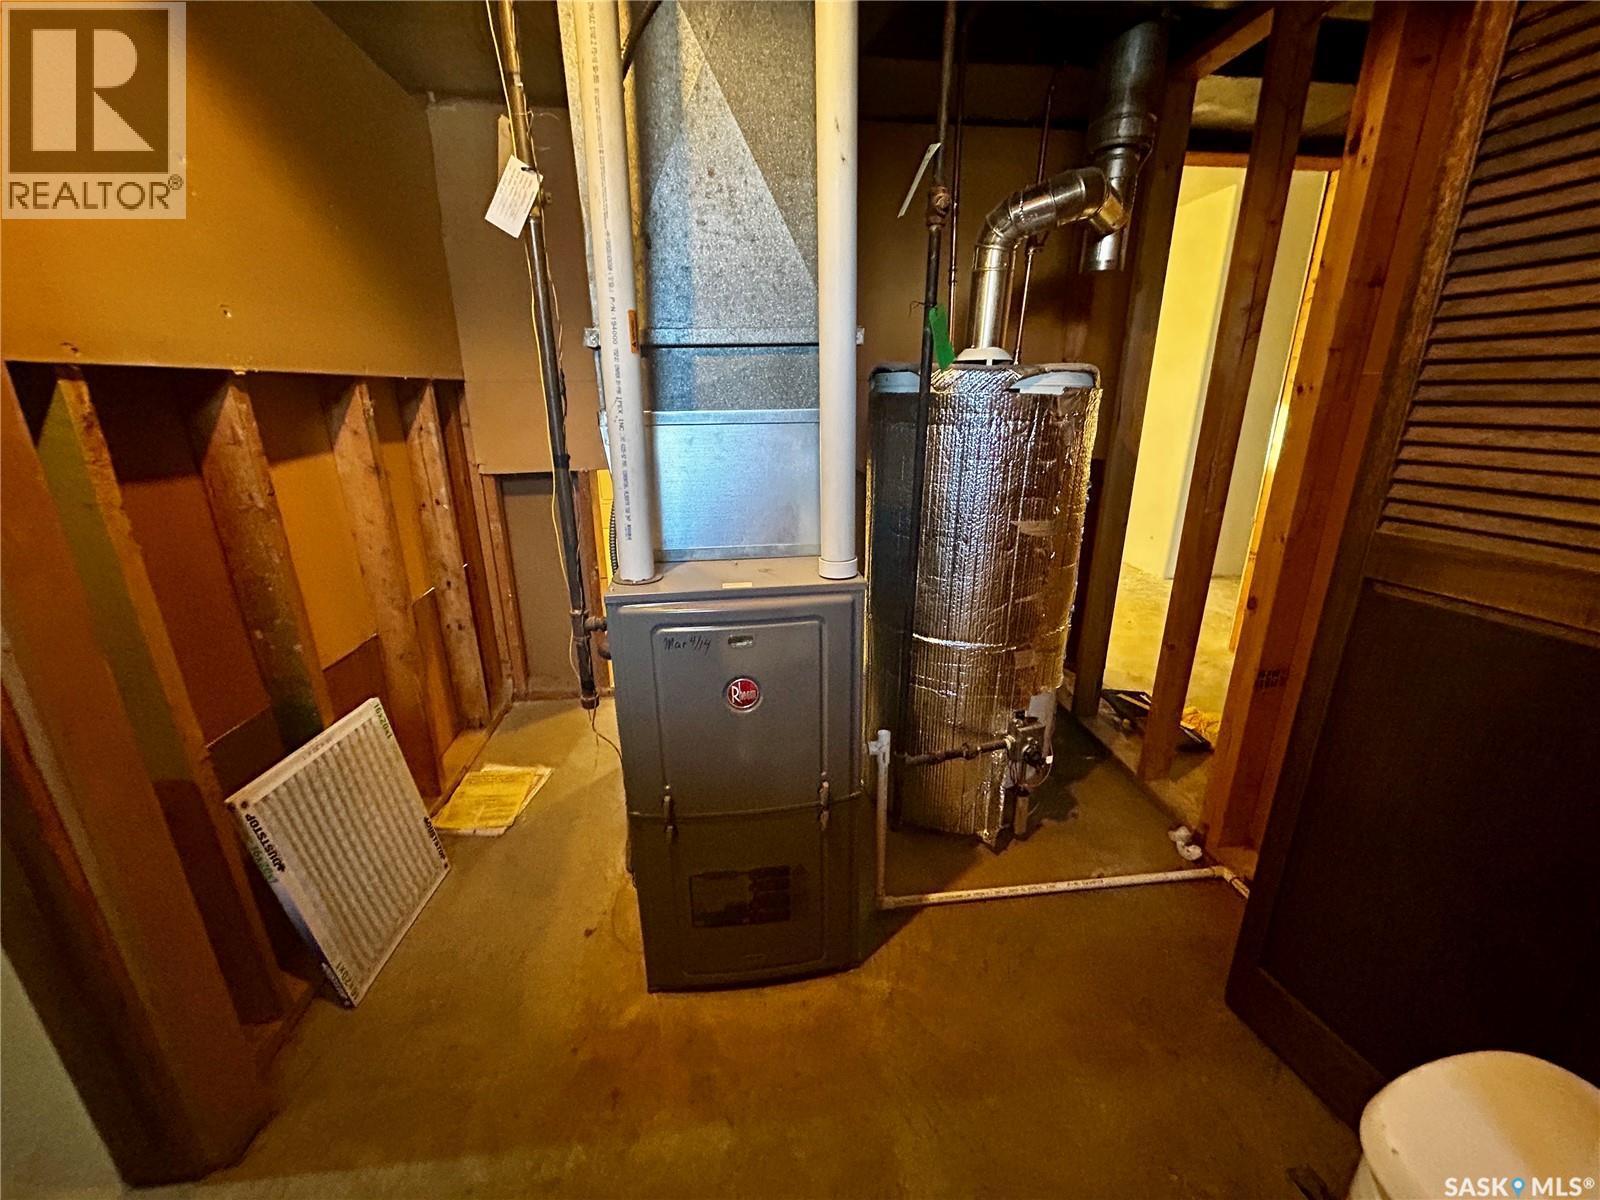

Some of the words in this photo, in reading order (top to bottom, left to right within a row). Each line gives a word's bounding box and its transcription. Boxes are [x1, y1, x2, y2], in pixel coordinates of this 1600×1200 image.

[663, 637, 687, 651] Mar
[245, 813, 283, 869] DUSTSTOP
[426, 820, 447, 862] DUSTSTOP
